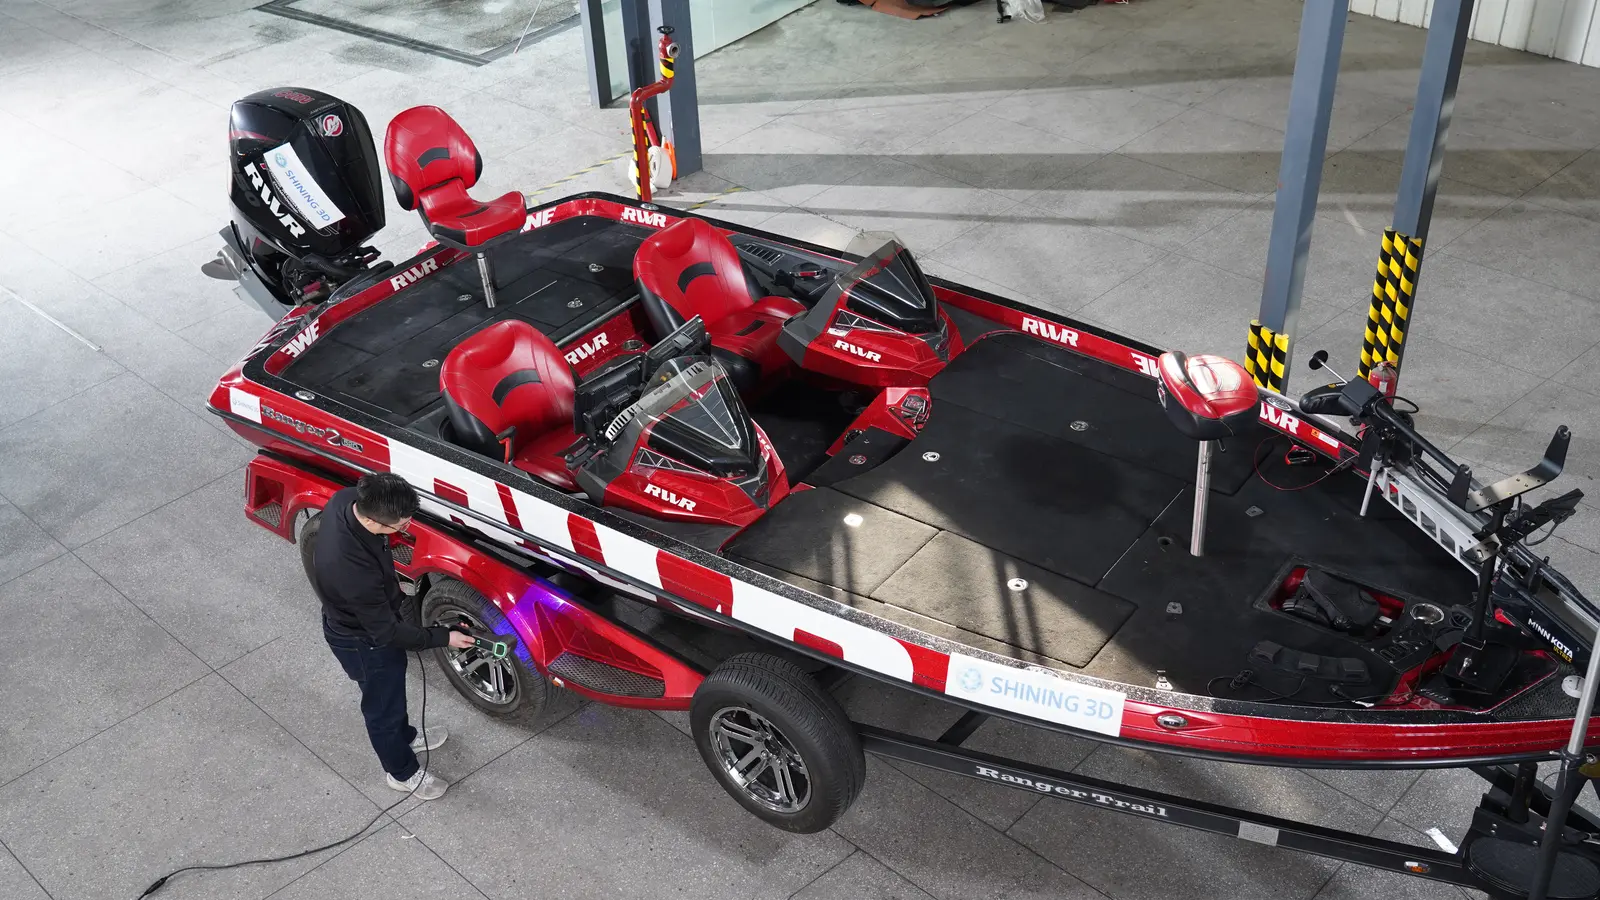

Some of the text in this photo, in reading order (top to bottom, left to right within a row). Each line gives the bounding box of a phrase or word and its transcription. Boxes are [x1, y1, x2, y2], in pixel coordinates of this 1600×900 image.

[243, 161, 306, 239] RWR
[285, 169, 320, 209] SHINING
[316, 206, 331, 222] 3D
[622, 206, 667, 228] RWR
[389, 257, 439, 291] RWR
[564, 332, 609, 365] RWR
[1021, 316, 1079, 348] RWR
[834, 339, 882, 363] RWR
[261, 404, 325, 437] Ranger
[1259, 402, 1300, 435] WR
[643, 483, 697, 512] RWR
[1527, 618, 1573, 659] MINN KOTA
[990, 676, 1114, 720] SHINING 3D
[976, 765, 1169, 817] Ranger Trail
